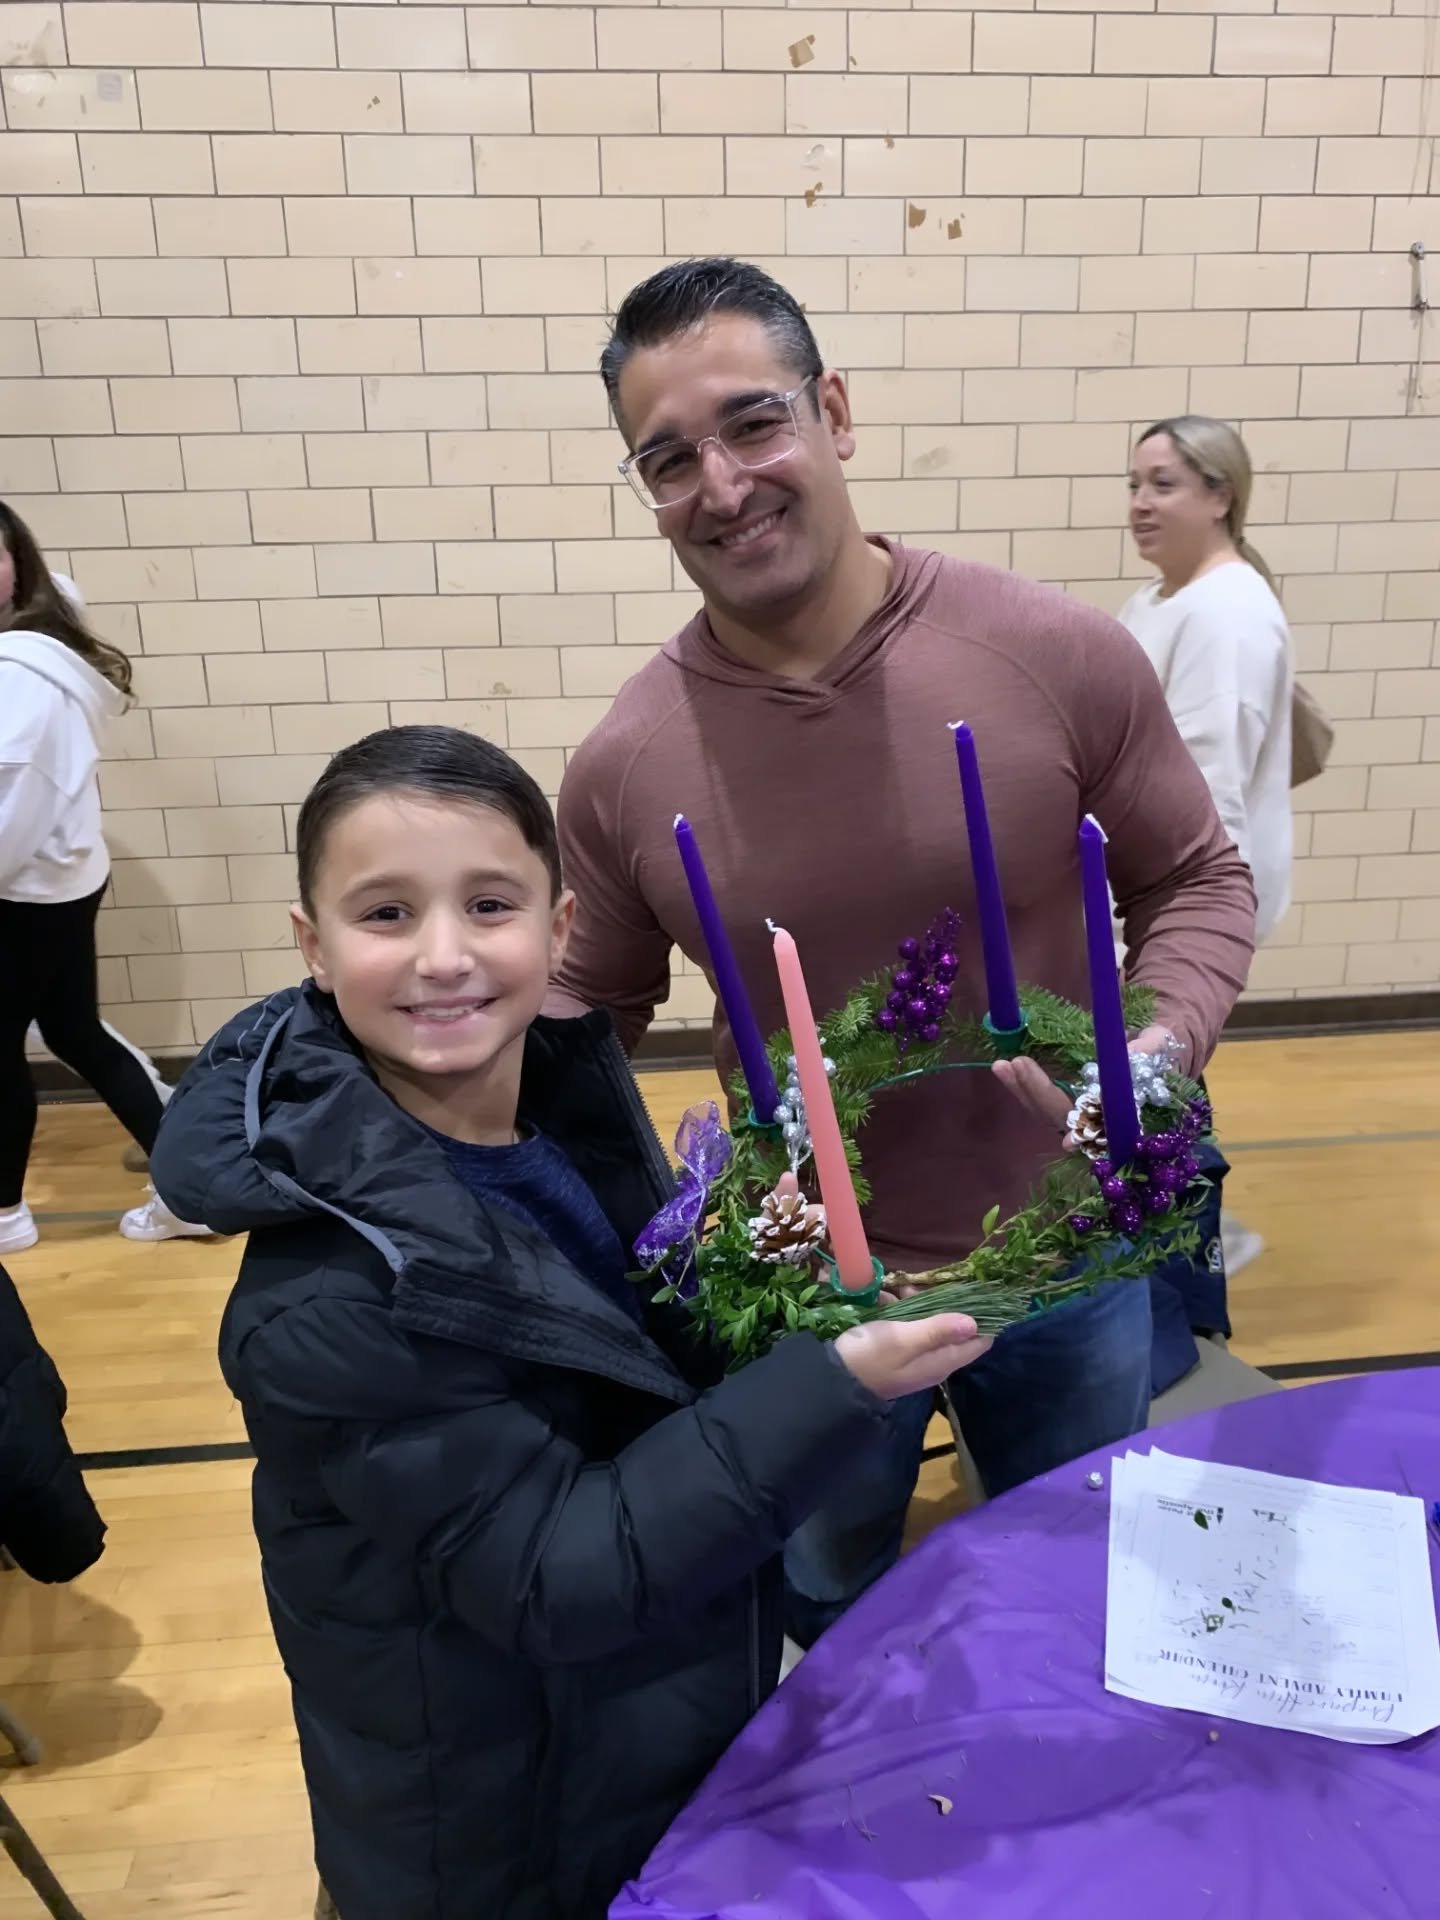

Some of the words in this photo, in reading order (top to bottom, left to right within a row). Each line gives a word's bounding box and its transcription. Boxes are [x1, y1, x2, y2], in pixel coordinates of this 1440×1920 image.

[1160, 1649, 1249, 1679] CALENDAR
[1258, 1672, 1327, 1695] ADVENT
[1337, 1687, 1403, 1702] FAMILY
